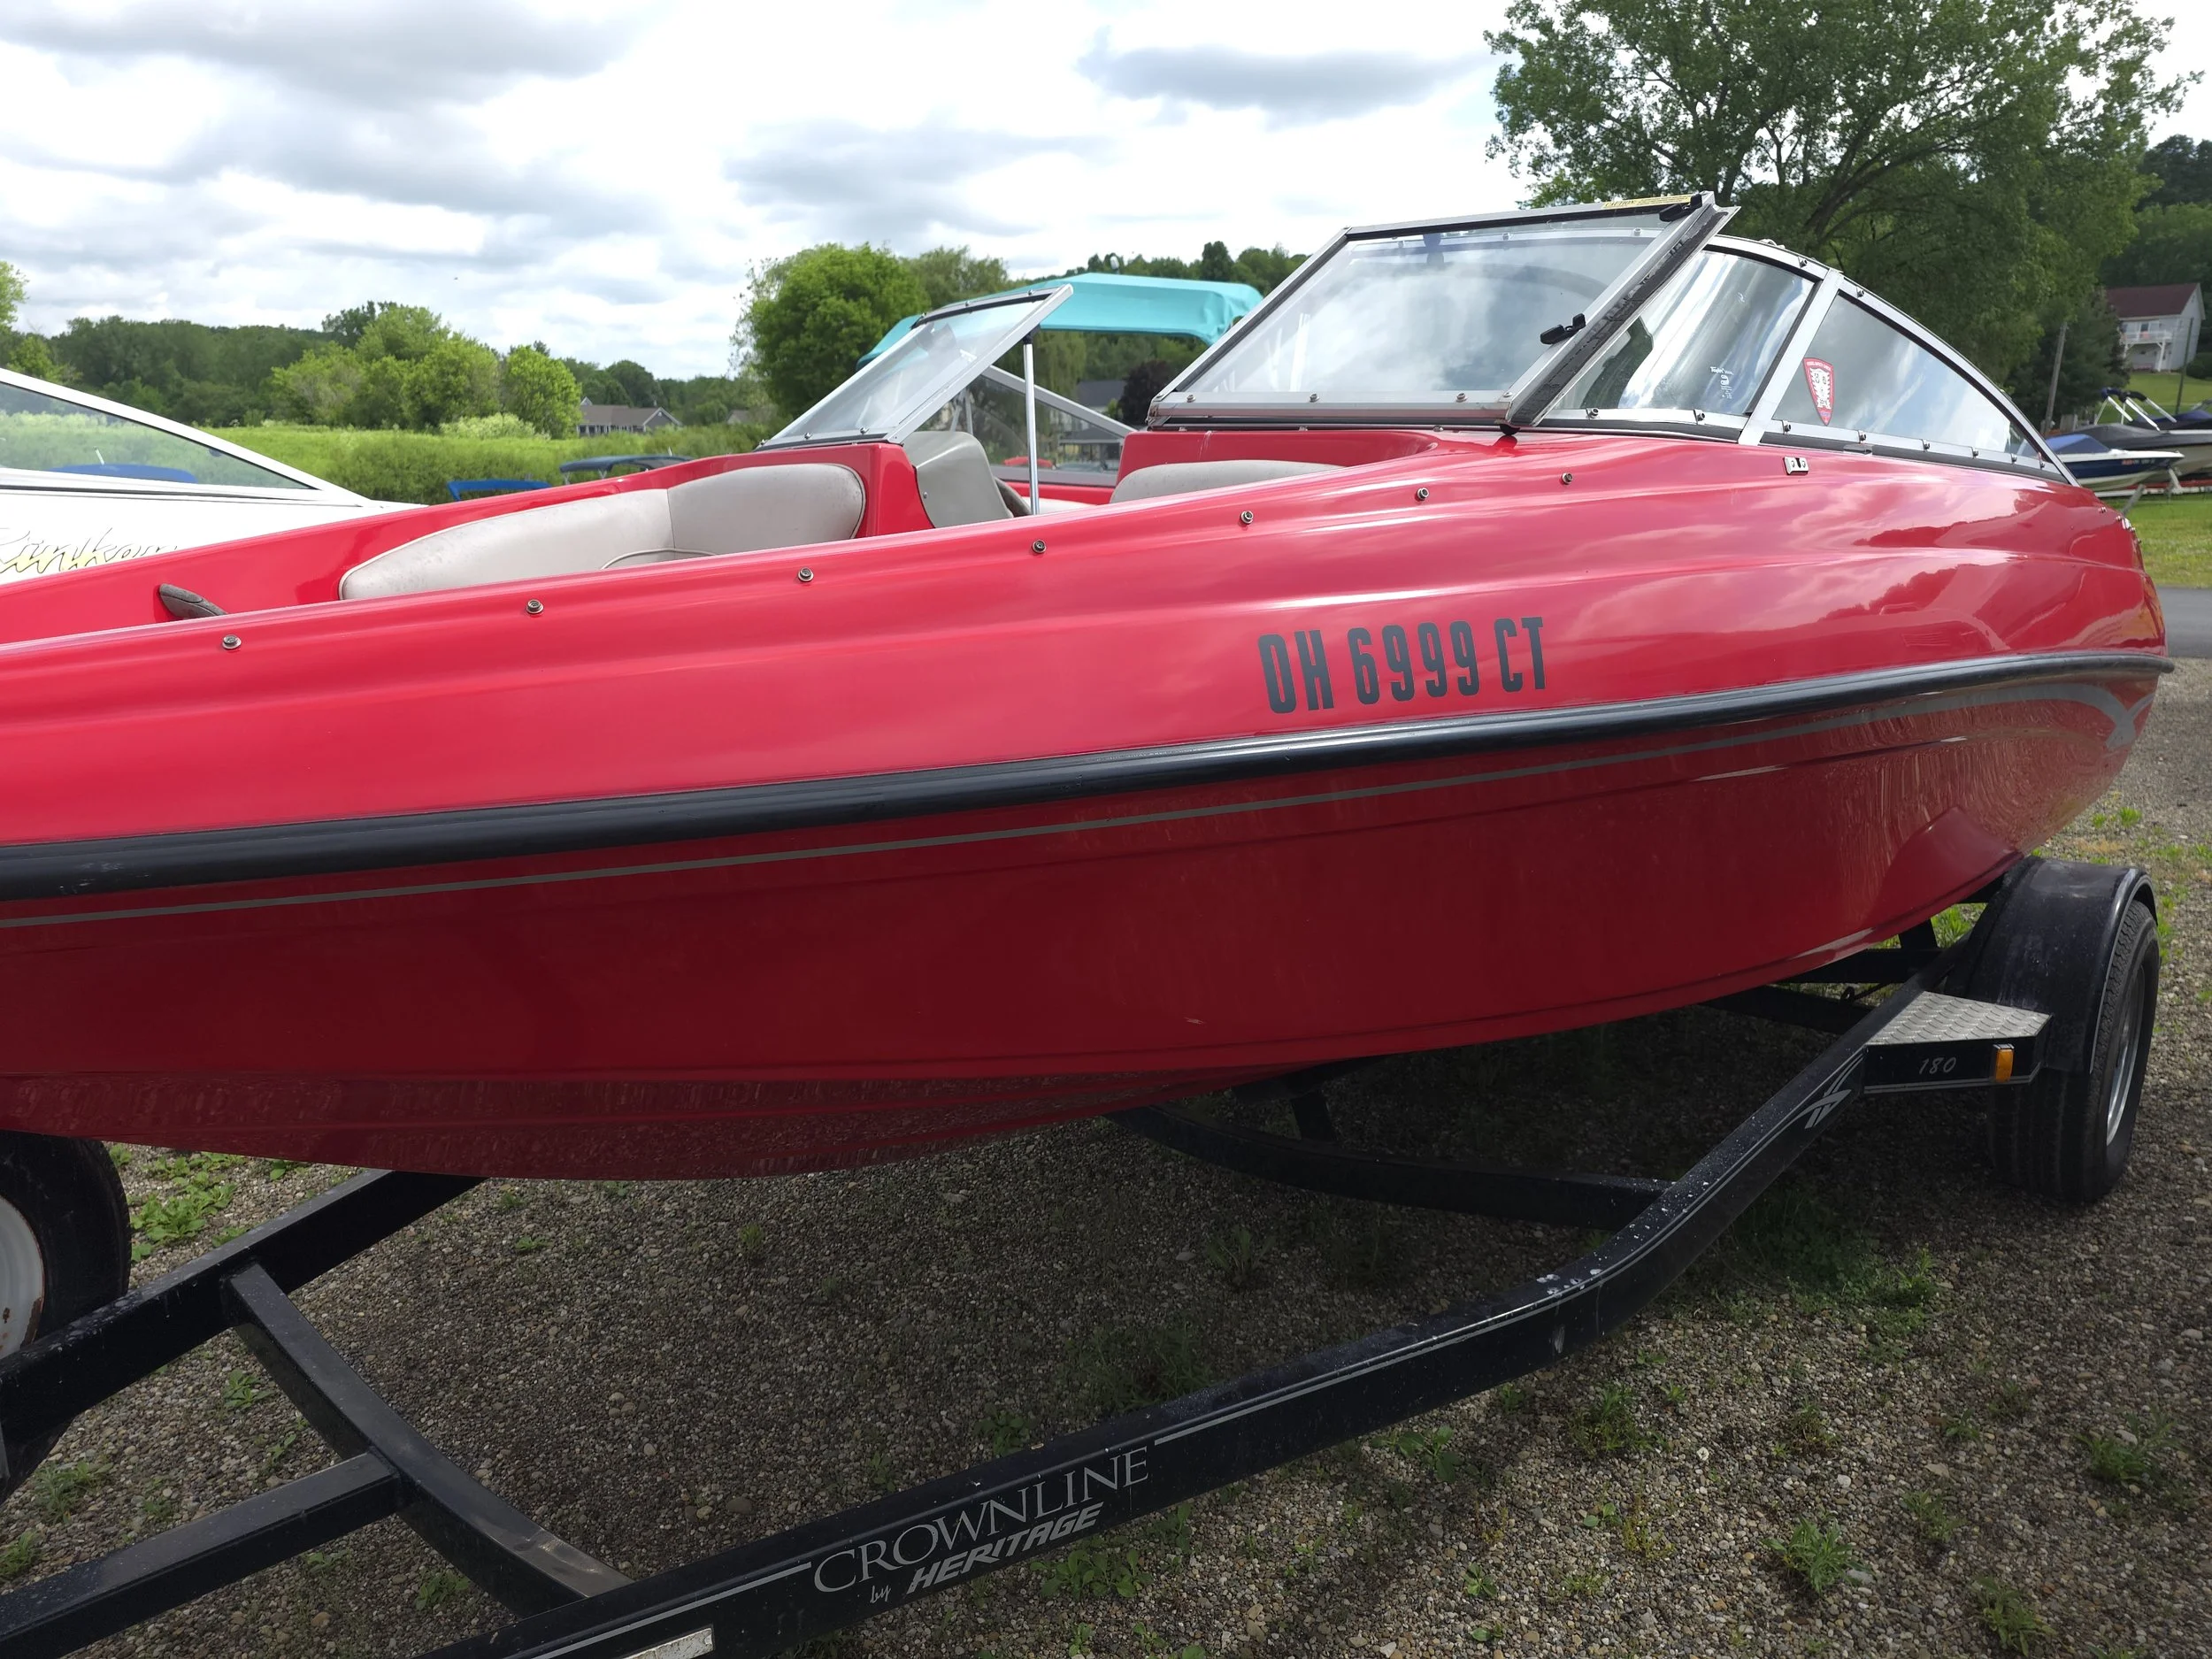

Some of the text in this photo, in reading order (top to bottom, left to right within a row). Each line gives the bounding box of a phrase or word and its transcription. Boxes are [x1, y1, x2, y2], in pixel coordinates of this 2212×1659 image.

[1257, 616, 1547, 714] OH 6999 CT
[1919, 1056, 1956, 1074] 180
[814, 1446, 1149, 1593] CROWNLINE
[869, 1502, 1104, 1604] by HERITAGE
